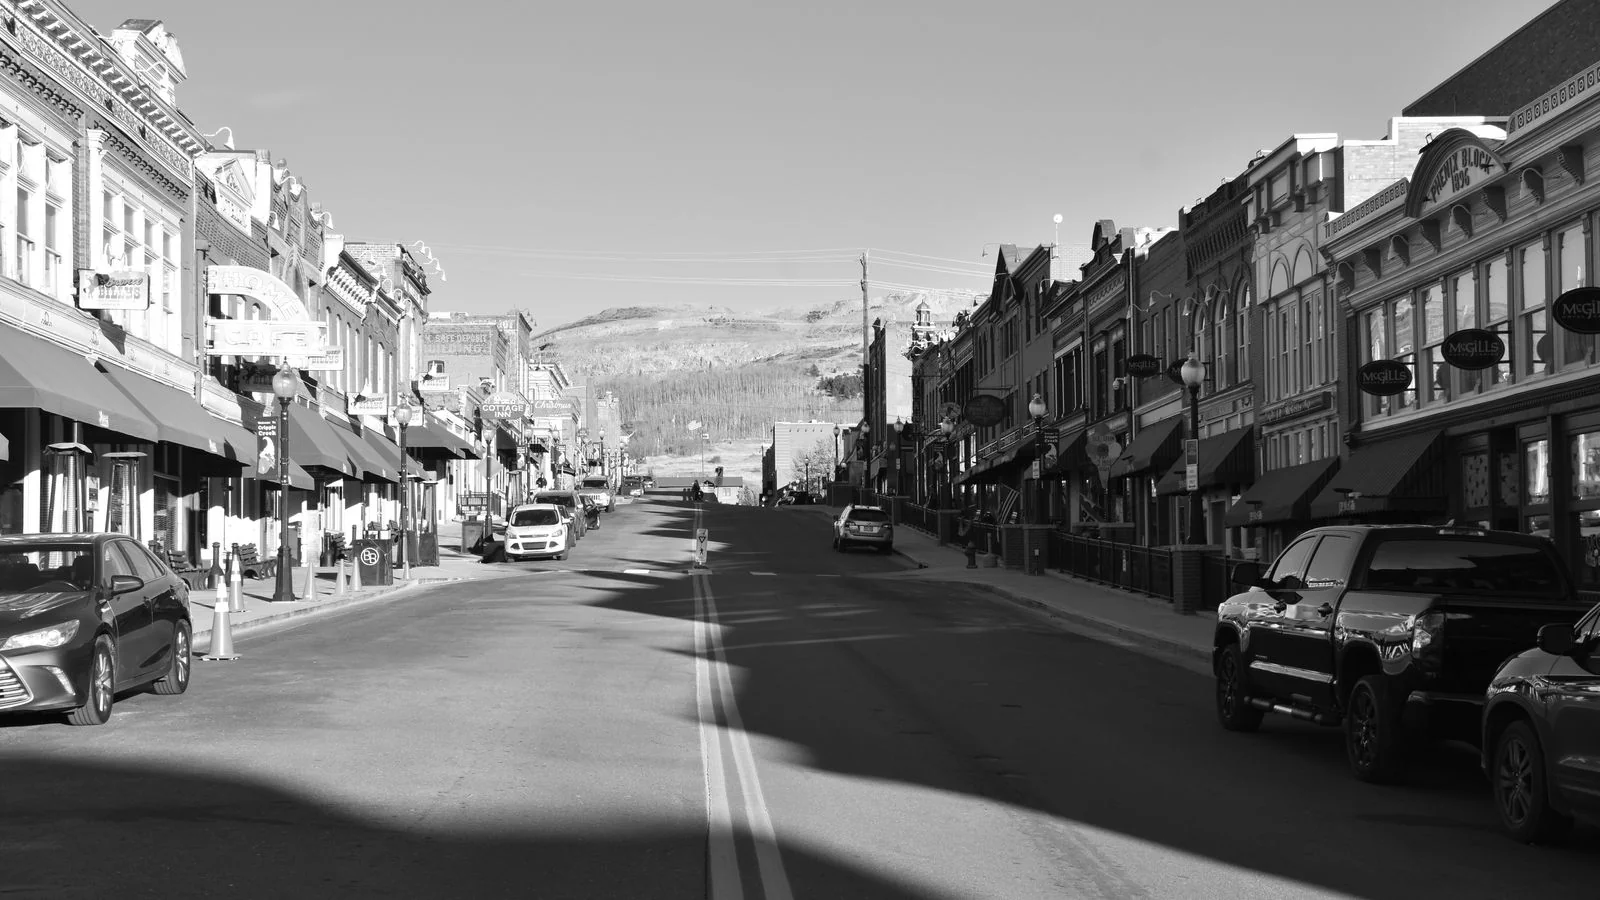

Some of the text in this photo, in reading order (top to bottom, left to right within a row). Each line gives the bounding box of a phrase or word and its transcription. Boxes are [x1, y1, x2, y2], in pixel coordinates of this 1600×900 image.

[1430, 148, 1492, 203] PHENIX BLOCK
[1451, 168, 1470, 193] 1896
[224, 328, 308, 347] CAFE
[482, 404, 525, 412] COTTAGE
